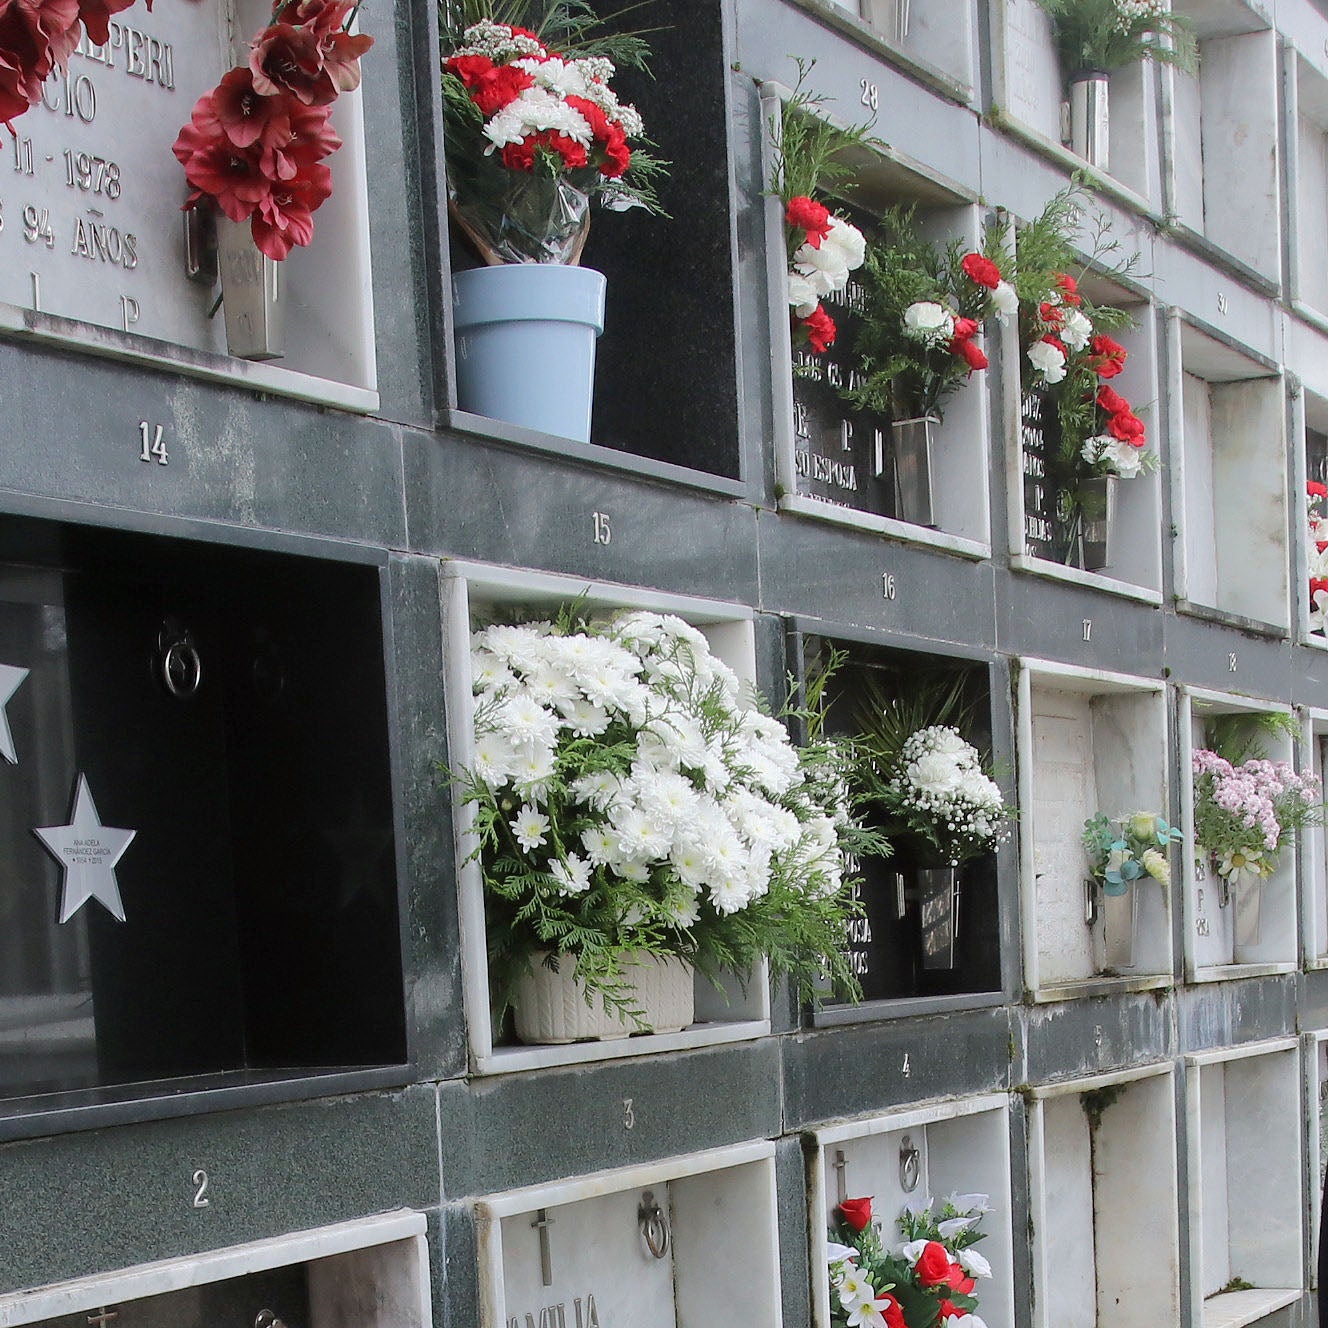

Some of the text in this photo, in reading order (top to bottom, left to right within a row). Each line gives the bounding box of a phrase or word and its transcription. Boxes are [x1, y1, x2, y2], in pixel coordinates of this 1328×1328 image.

[41, 67, 99, 122] CIO
[860, 79, 877, 110] 28
[63, 148, 122, 201] 1978
[23, 203, 55, 249] 94
[72, 208, 138, 270] AÑOS
[120, 294, 140, 333] P
[139, 421, 168, 465] 14
[812, 453, 858, 491] ESPOSA
[592, 511, 611, 545] 15
[882, 572, 895, 600] 16
[902, 1053, 911, 1078] 4
[623, 1098, 634, 1130] 3
[192, 1169, 209, 1208] 2
